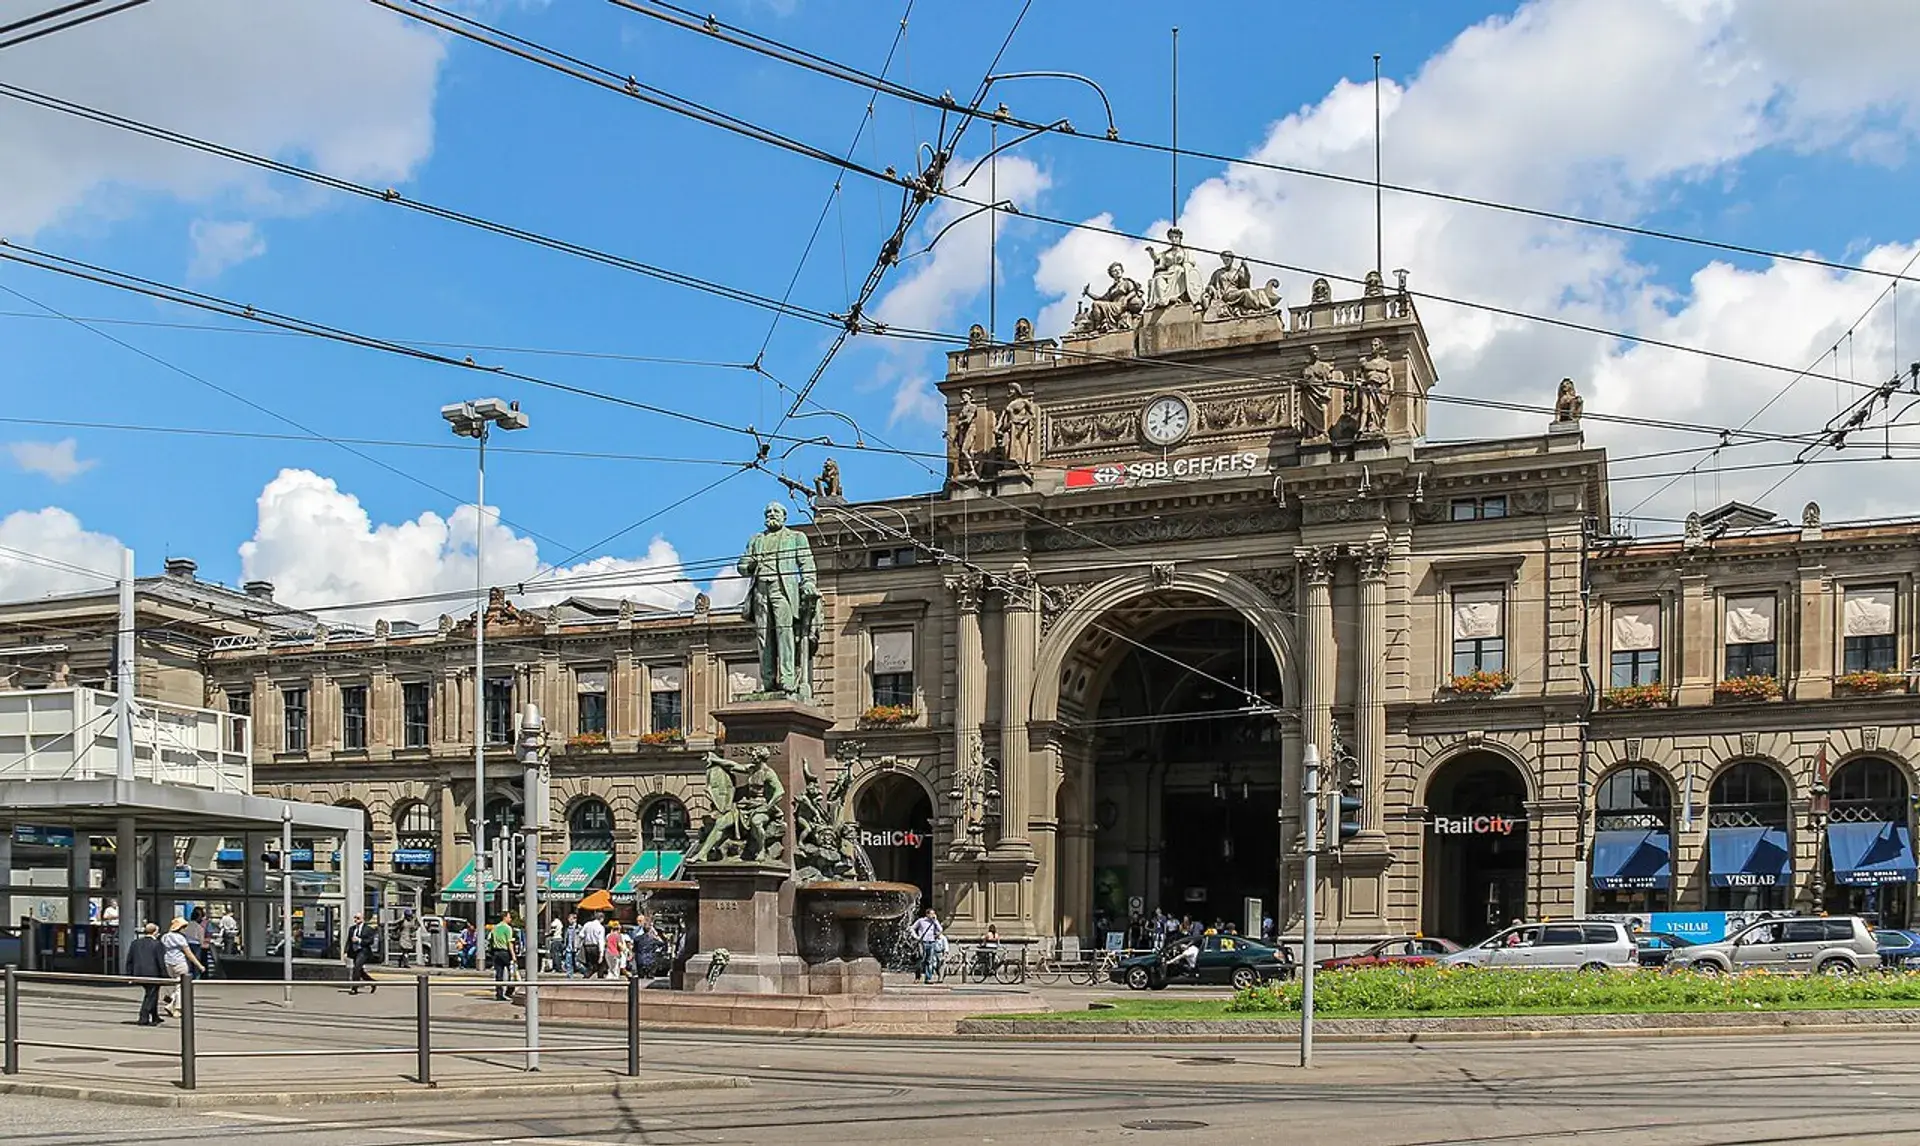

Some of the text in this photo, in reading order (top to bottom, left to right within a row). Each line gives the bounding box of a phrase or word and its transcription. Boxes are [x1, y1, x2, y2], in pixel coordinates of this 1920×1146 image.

[1129, 461, 1169, 479] SBB
[1434, 814, 1514, 835] RailCity
[860, 829, 924, 849] RailCity
[1726, 874, 1776, 886] VISILAB
[1666, 922, 1709, 931] VISILAB
